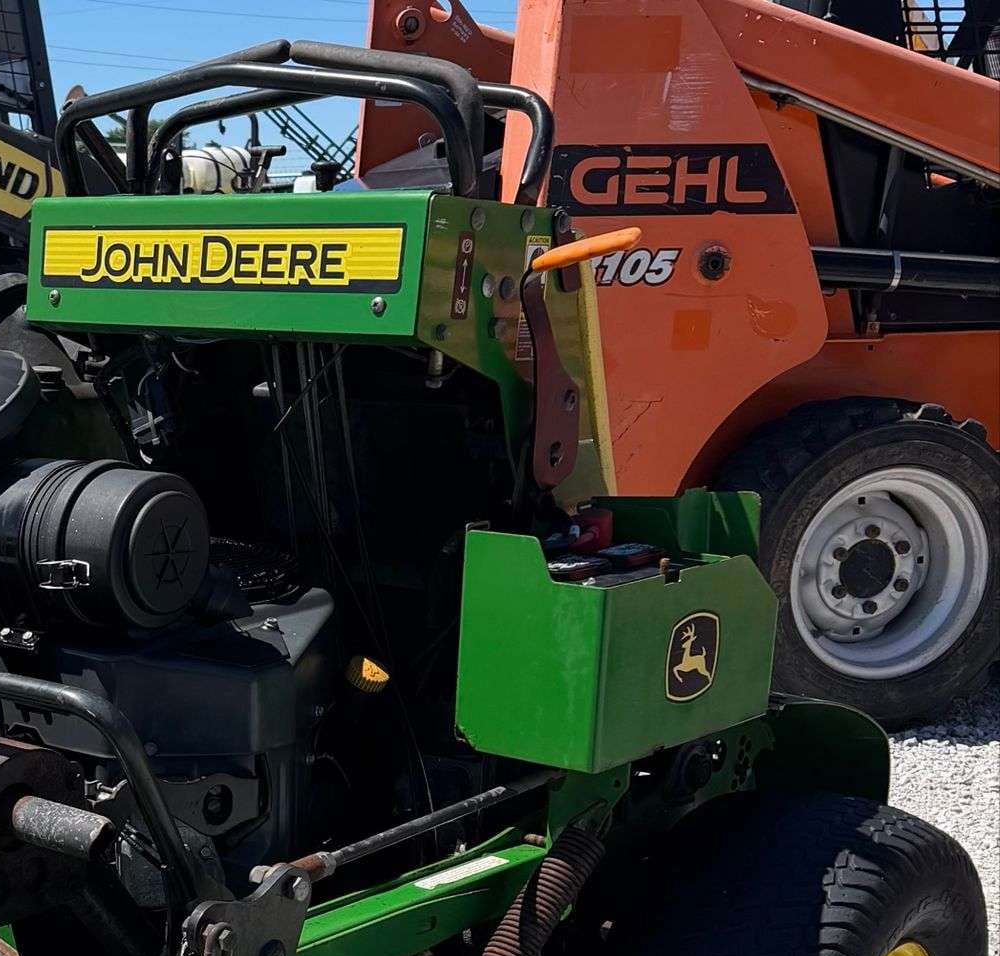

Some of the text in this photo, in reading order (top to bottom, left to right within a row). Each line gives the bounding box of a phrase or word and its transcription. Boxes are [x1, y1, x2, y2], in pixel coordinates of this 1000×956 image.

[569, 154, 768, 206] GEHL
[81, 234, 349, 281] JOHN DEERE
[592, 247, 683, 287] 105
